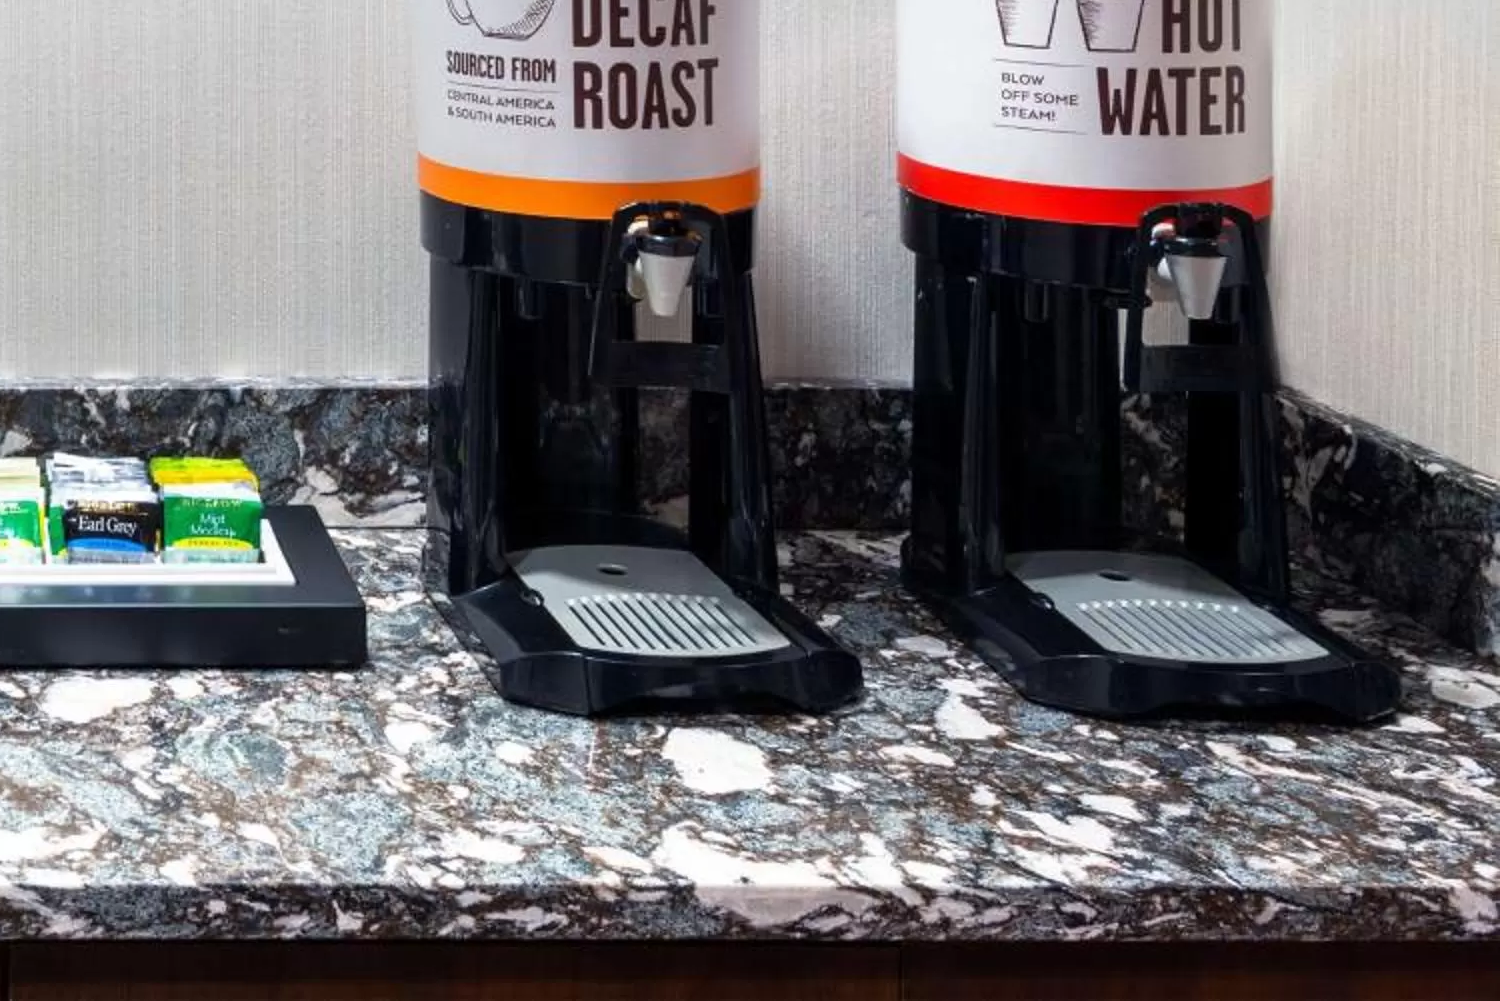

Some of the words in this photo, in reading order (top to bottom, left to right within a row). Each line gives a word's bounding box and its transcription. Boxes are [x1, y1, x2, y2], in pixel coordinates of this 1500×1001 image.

[446, 49, 505, 79] SOURCED
[511, 56, 556, 83] FROM
[1001, 72, 1044, 85] BLOW
[496, 95, 555, 110] AMERICA
[573, 58, 720, 130] ROAST
[1001, 88, 1029, 102] OFF
[1033, 92, 1079, 106] SOME
[1097, 66, 1246, 136] WATER
[455, 106, 493, 121] SOUTH
[495, 113, 557, 128] AMERICA
[1001, 105, 1056, 121] STEAM!
[78, 515, 105, 532] Earl
[106, 516, 137, 538] Grey
